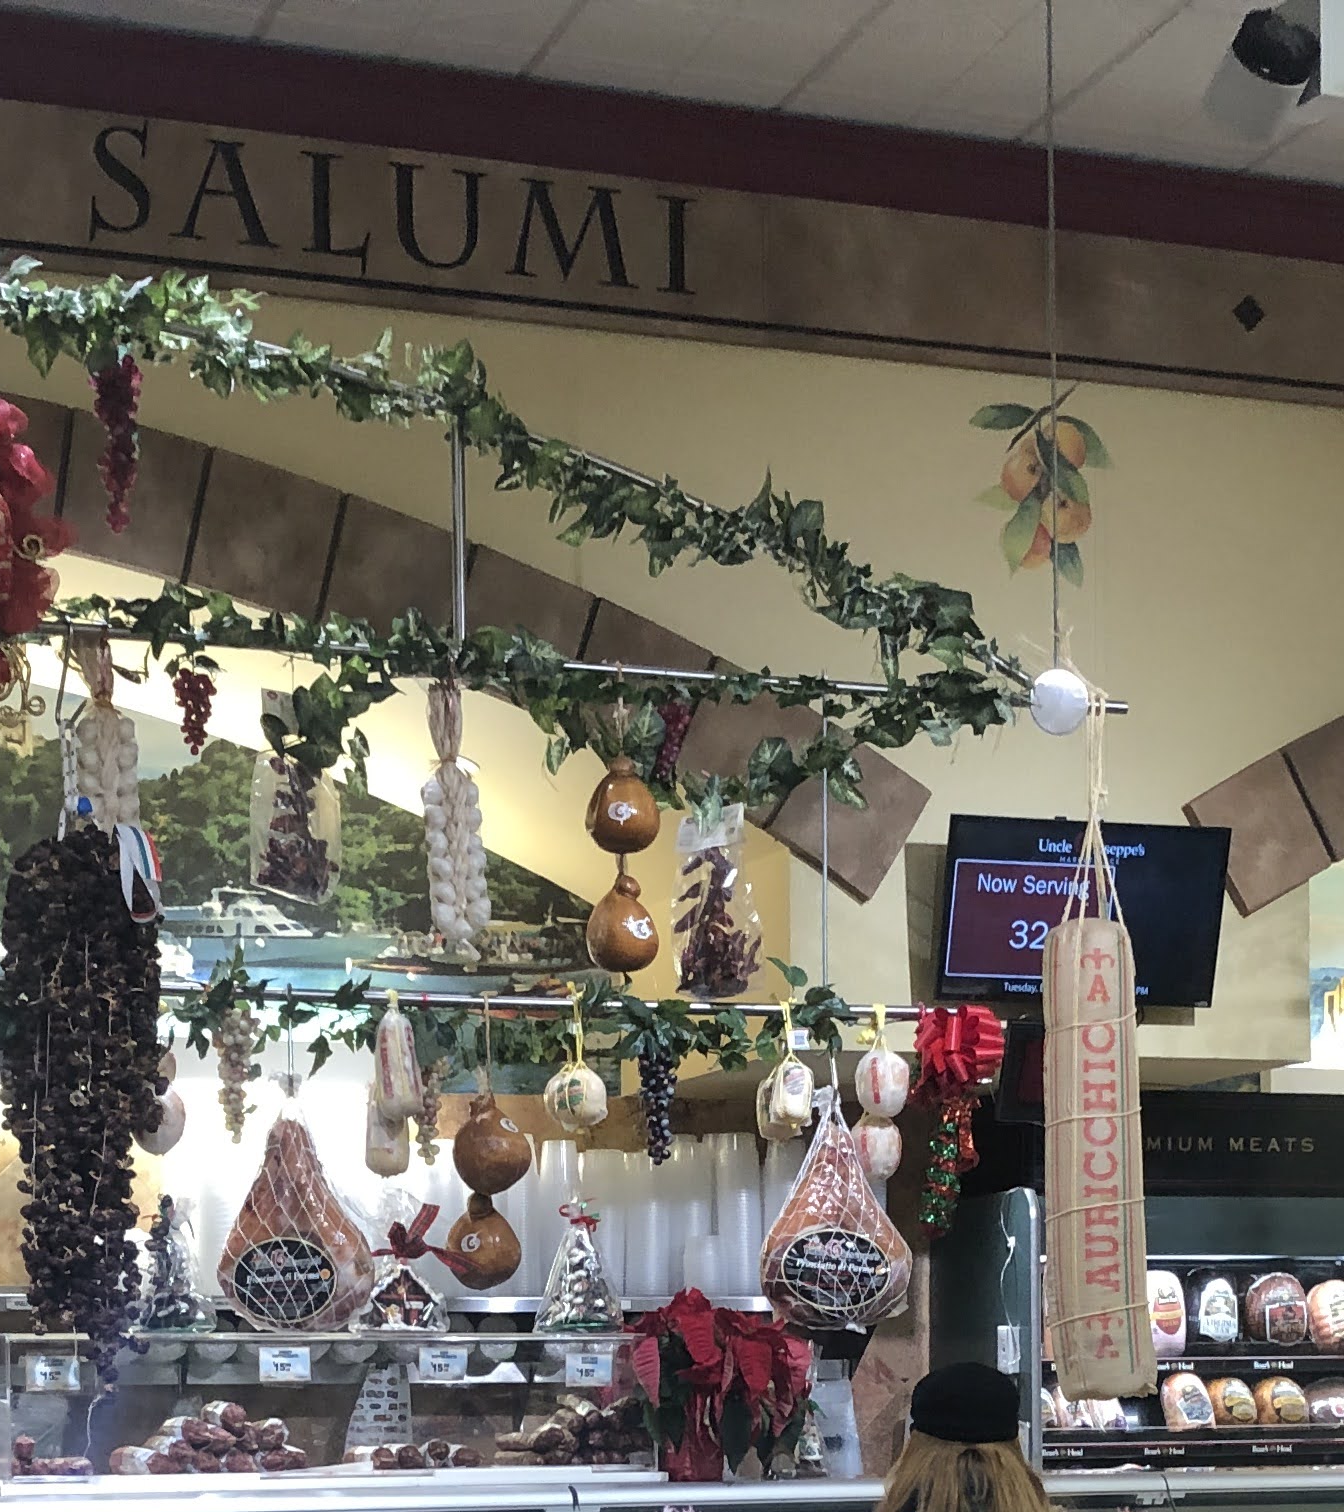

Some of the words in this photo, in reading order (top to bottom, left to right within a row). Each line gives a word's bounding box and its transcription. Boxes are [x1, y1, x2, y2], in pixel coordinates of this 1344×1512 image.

[88, 119, 697, 296] SALUMI
[1038, 838, 1073, 854] Uncle
[977, 872, 1018, 894] Now
[1022, 874, 1091, 900] Serving
[1082, 1020, 1121, 1293] AURICCHIO
[1146, 1136, 1214, 1153] MIUM
[1228, 1136, 1316, 1154] MEATS
